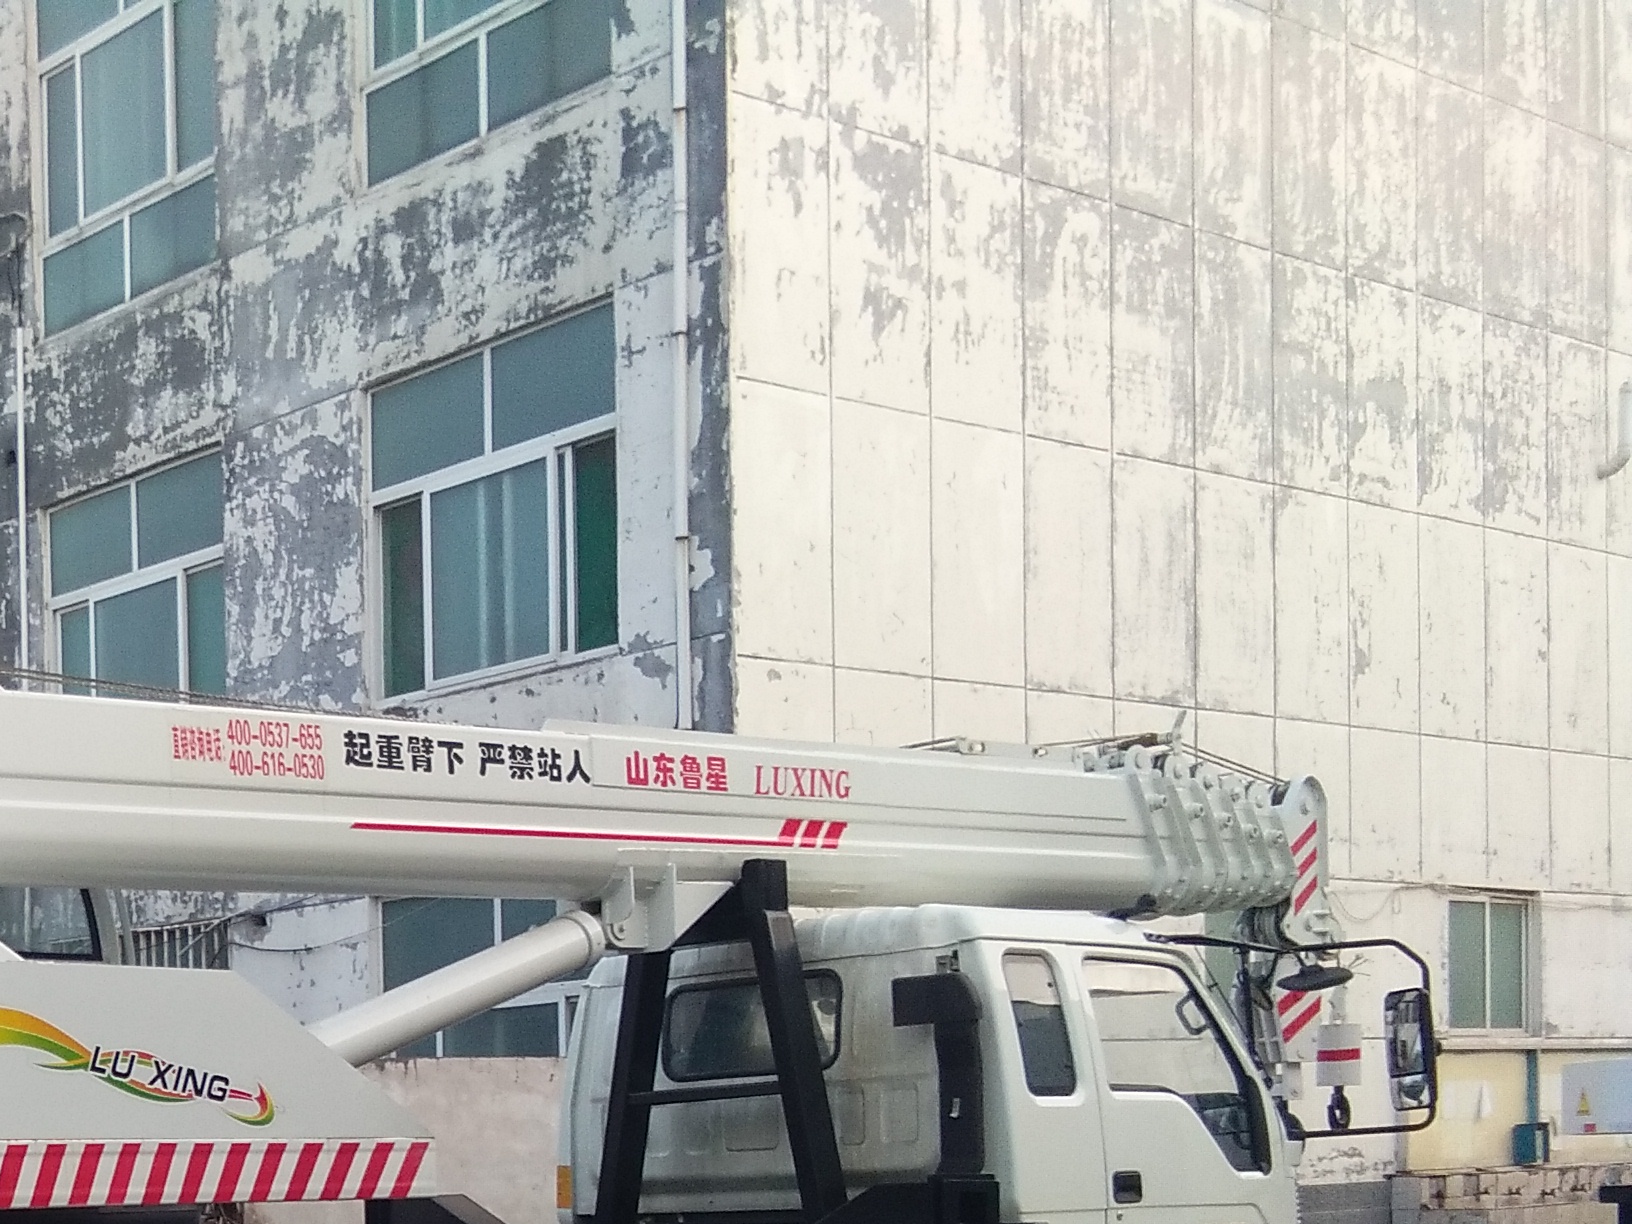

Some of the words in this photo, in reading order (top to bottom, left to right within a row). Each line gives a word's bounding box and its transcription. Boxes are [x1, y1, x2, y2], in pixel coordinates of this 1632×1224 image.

[227, 718, 323, 752] 400-0537-655
[229, 749, 325, 780] 400-616-0530
[343, 729, 465, 775] 起重臂下
[478, 741, 591, 784] 严禁站人
[625, 750, 729, 792] 山东鲁星
[755, 764, 852, 799] LUXING
[89, 1046, 136, 1080] LU
[148, 1059, 230, 1101] XING
